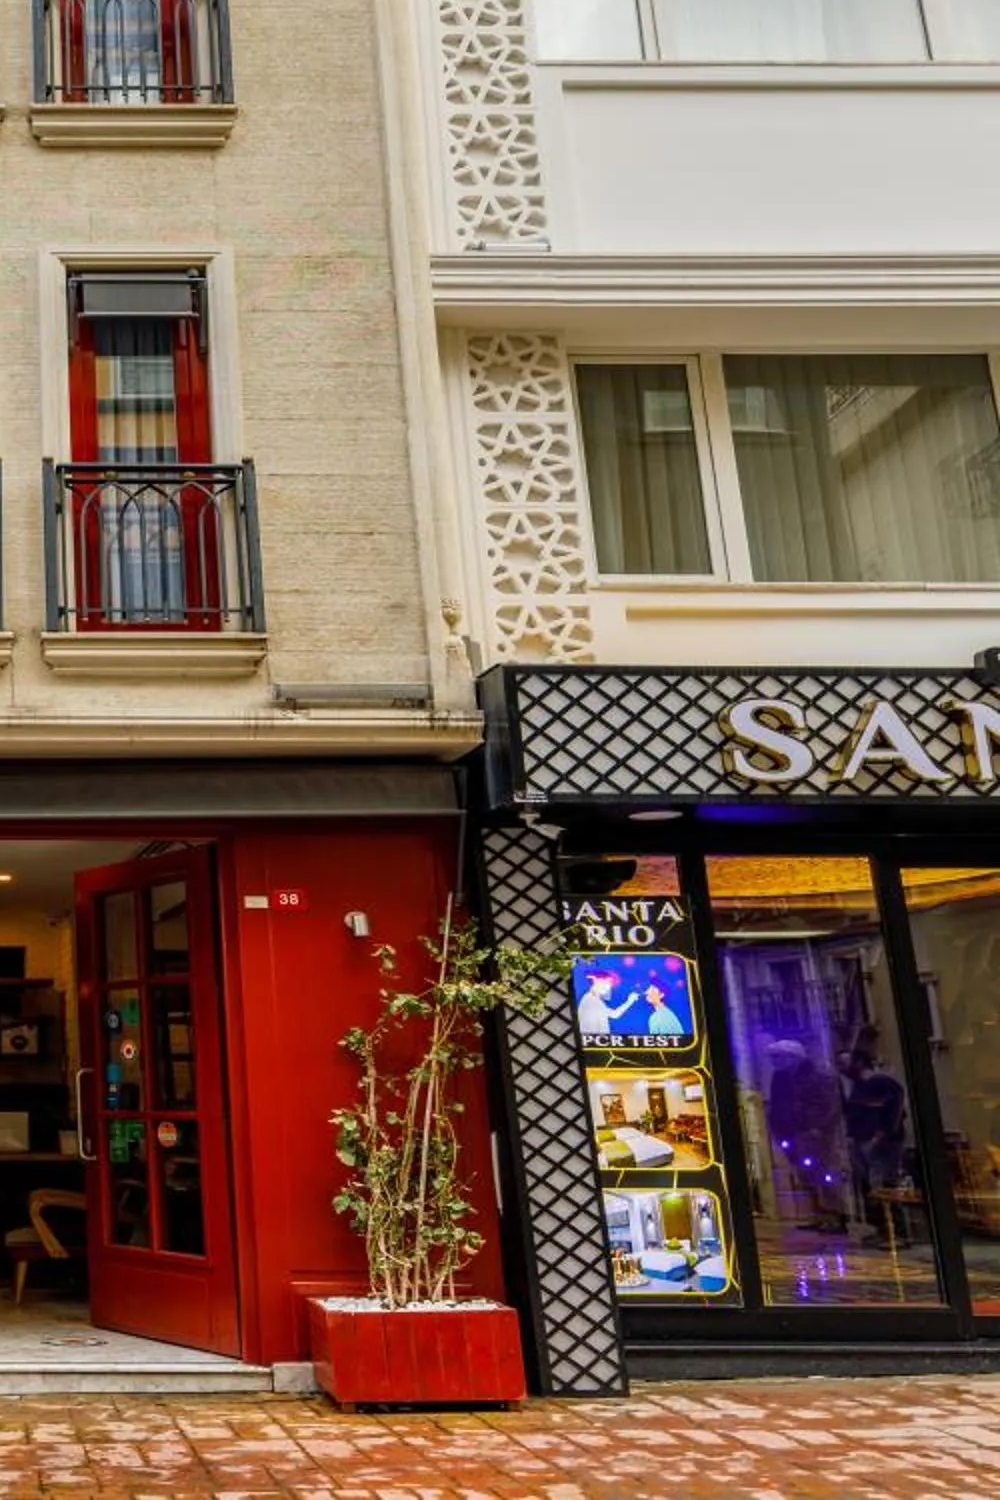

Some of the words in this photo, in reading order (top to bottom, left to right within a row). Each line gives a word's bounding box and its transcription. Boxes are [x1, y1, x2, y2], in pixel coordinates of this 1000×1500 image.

[279, 893, 299, 905] 38
[584, 925, 656, 946] RIO
[582, 1035, 625, 1047] PCR
[628, 1035, 682, 1047] TEST
